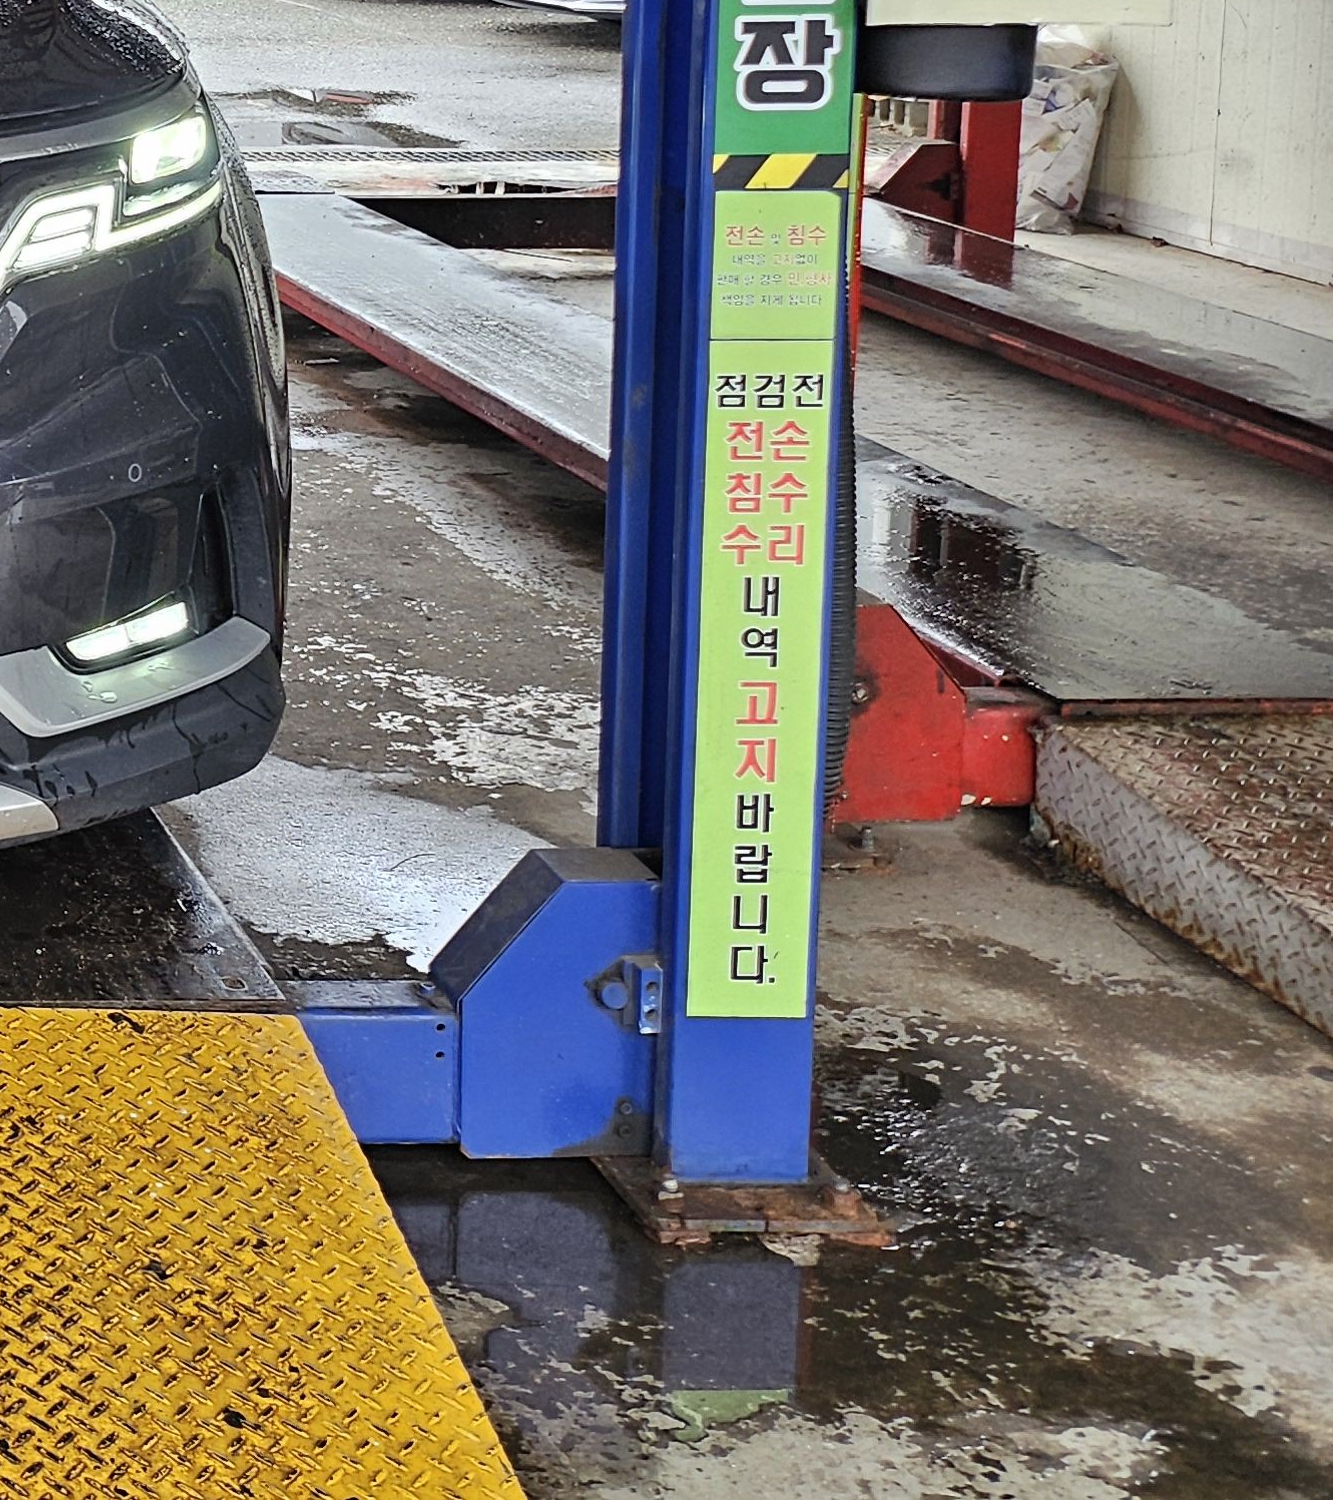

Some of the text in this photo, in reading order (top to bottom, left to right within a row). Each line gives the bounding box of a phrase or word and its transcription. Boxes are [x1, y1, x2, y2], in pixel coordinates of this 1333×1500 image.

[725, 225, 765, 246] 전손
[787, 224, 827, 247] 침수
[713, 373, 825, 410] 점검전
[724, 419, 813, 463] 전손
[724, 470, 809, 515] 침수
[719, 522, 806, 567] 수리
